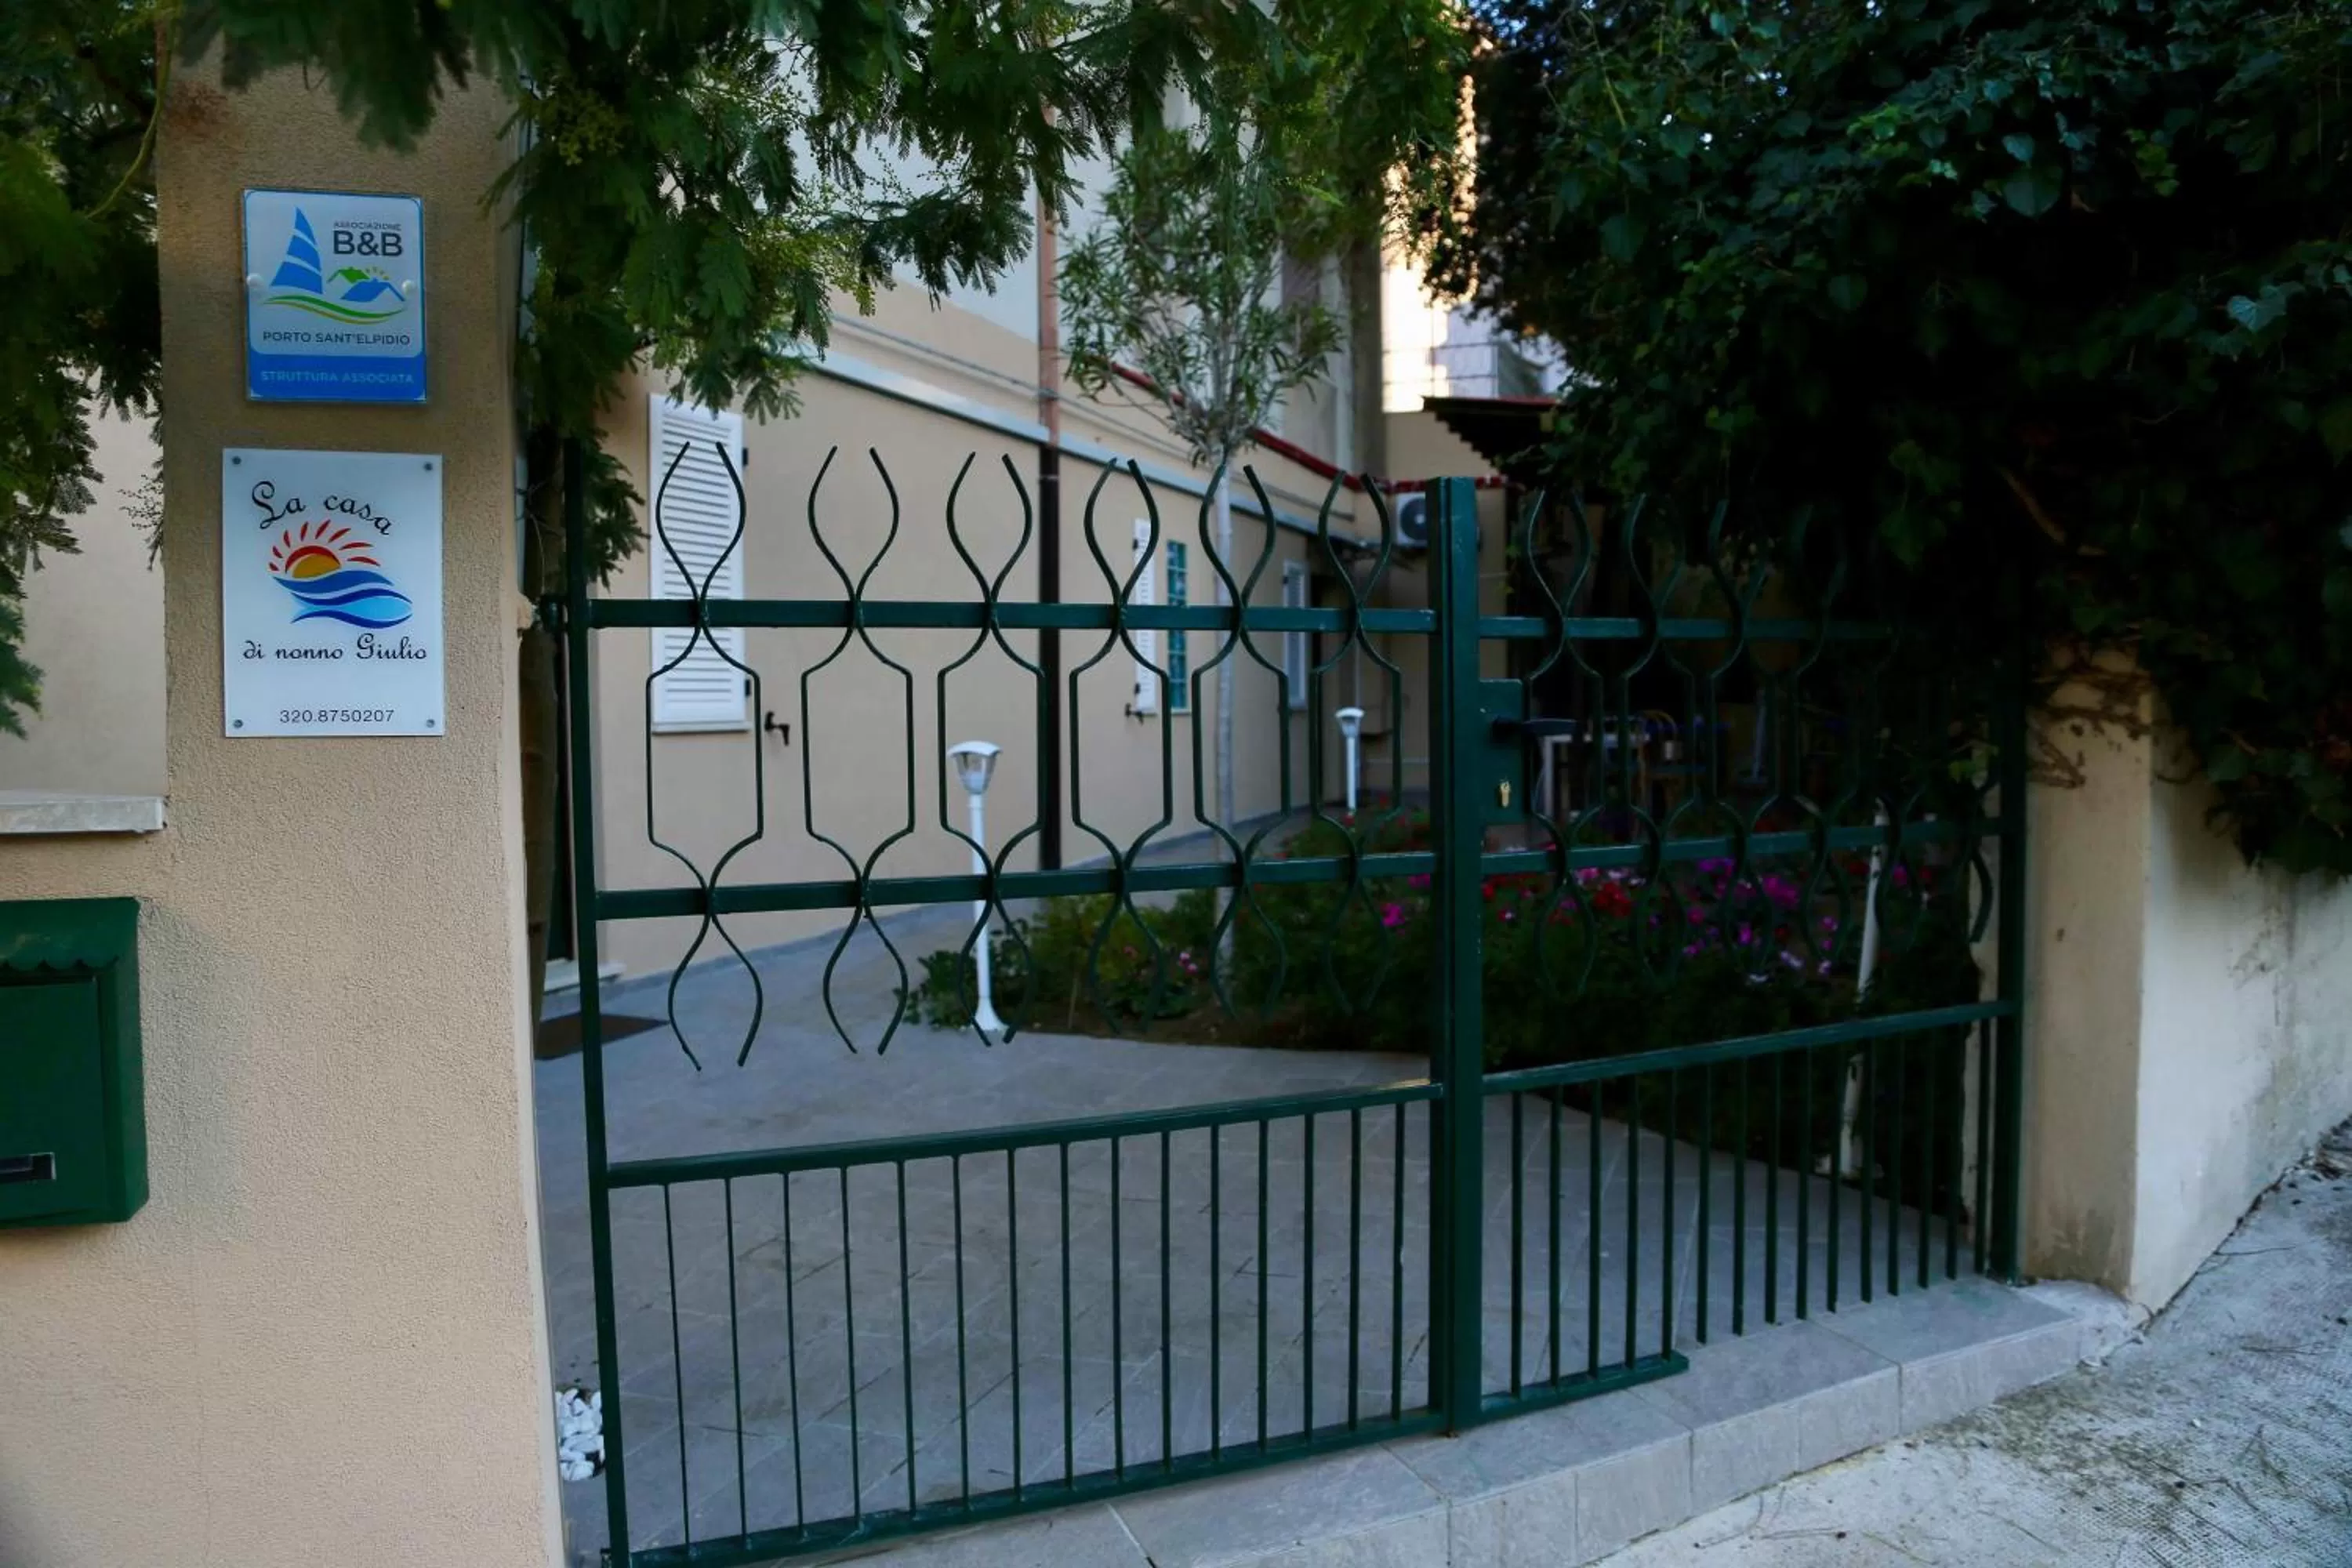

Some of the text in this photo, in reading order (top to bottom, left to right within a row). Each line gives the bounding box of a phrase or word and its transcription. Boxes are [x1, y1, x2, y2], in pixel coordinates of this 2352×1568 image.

[333, 230, 403, 256] B&B
[263, 330, 411, 346] PORTO SANT'ELPIDIO
[260, 369, 414, 384] STRUTTURA ASSOCIATA
[251, 481, 392, 535] La casa
[243, 633, 427, 660] di nonno Giulio
[279, 710, 395, 724] 320.8750207
